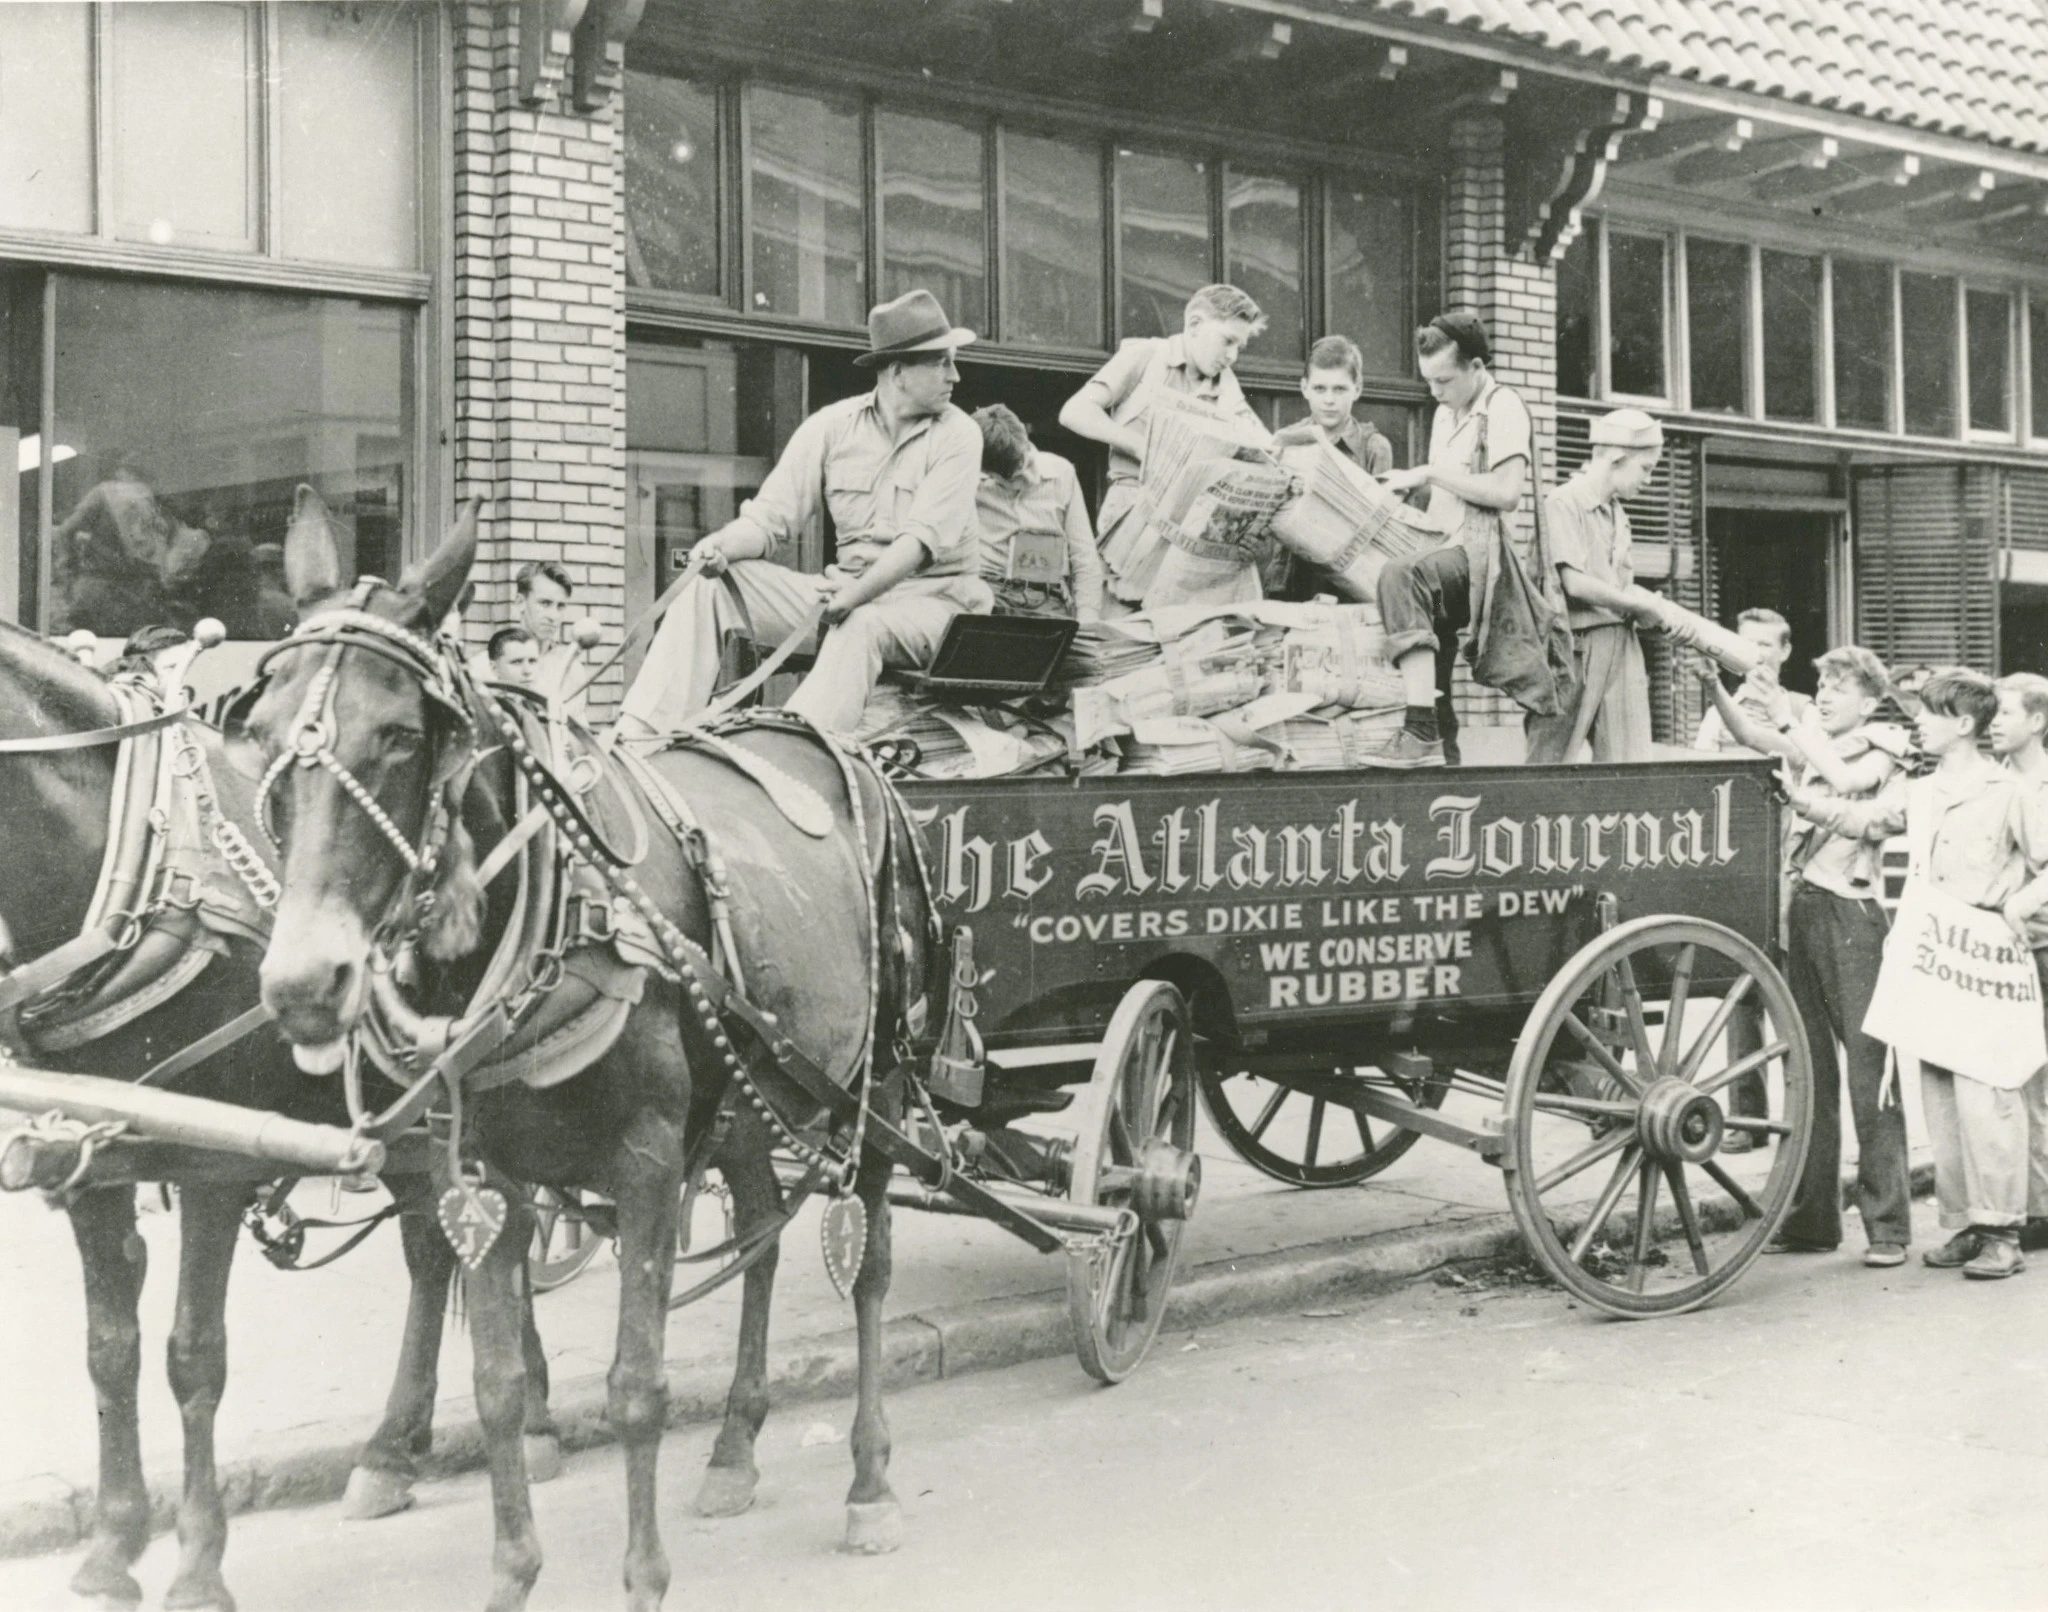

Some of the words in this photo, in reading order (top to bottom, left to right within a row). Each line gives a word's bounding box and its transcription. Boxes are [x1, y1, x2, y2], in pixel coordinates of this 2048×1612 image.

[1076, 798, 1411, 901] Atlanta
[1425, 778, 1741, 881] Journal
[1012, 909, 1190, 944] “COVERS
[1206, 903, 1303, 934] DIXIE
[1321, 899, 1401, 927] LIKE
[1413, 893, 1484, 922] THE
[1498, 884, 1585, 918] DEW”
[1259, 941, 1311, 973] WE
[1318, 930, 1473, 968] CONSERVE
[1911, 943, 2038, 1003] Journal
[1268, 964, 1462, 1009] RUBBER
[457, 1196, 482, 1224] A
[840, 1208, 855, 1237] A
[455, 1225, 477, 1256] J
